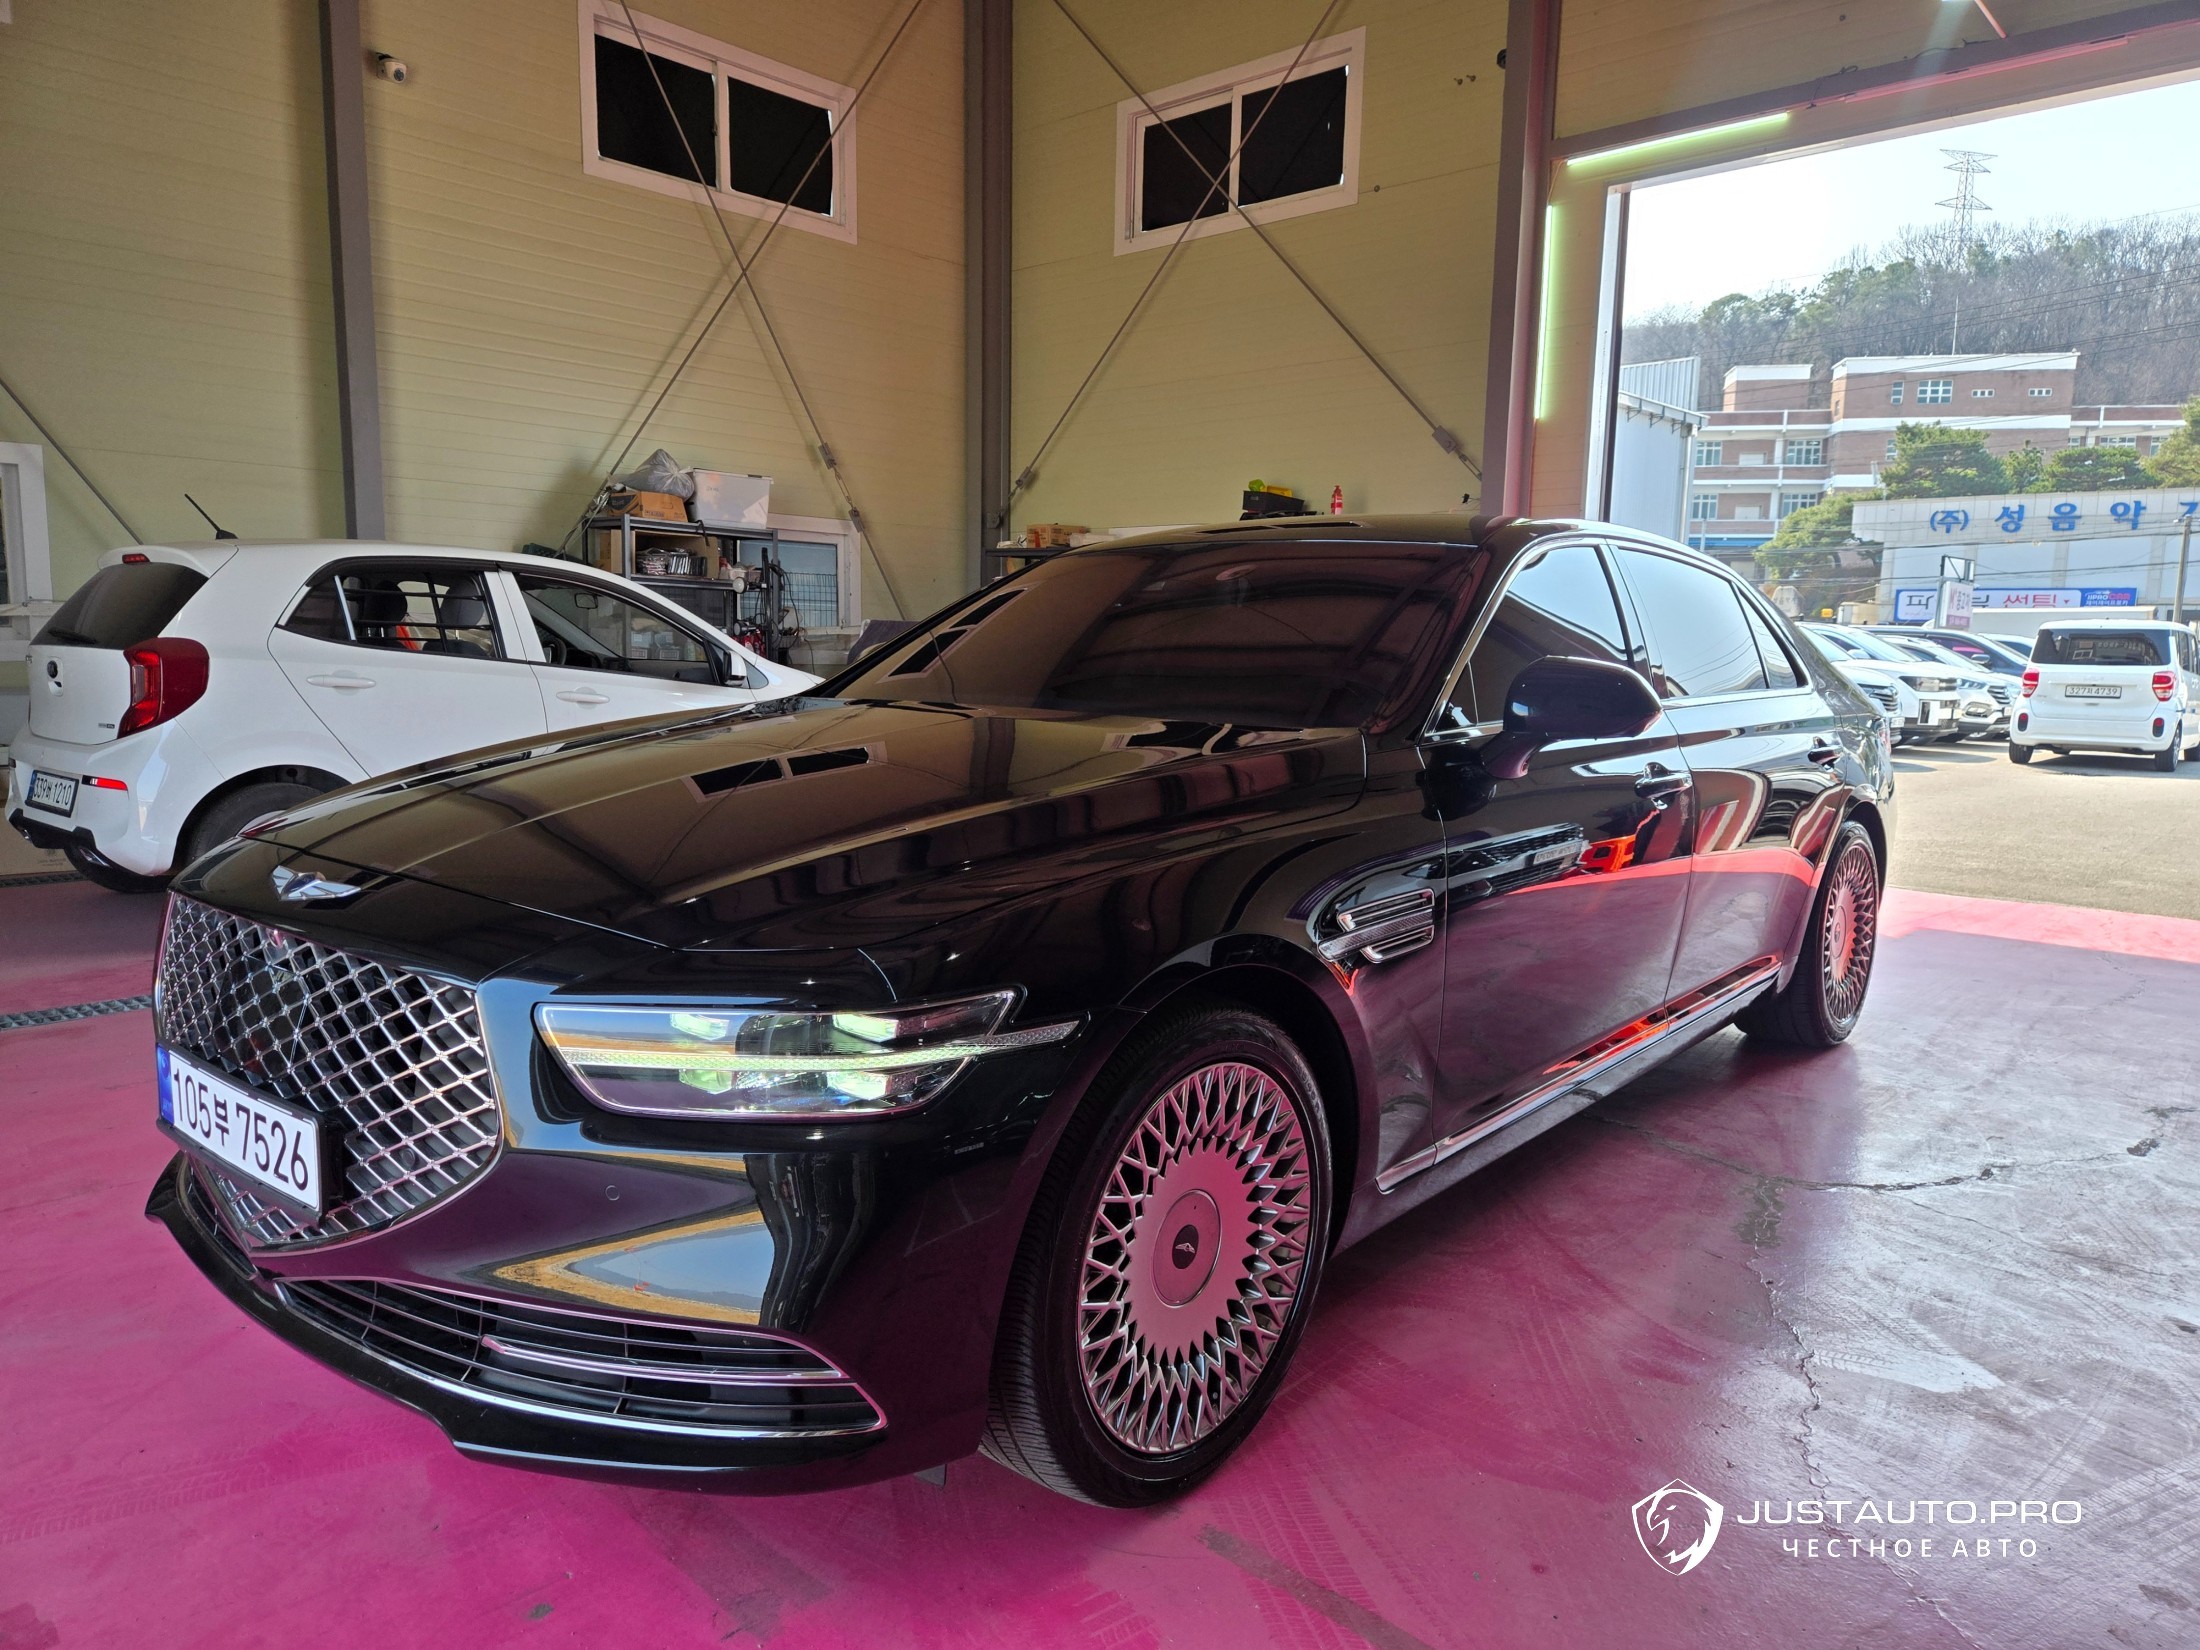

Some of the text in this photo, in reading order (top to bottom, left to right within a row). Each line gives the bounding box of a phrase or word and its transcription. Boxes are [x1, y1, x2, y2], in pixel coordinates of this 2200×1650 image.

[1930, 509, 1969, 533] (주)
[2094, 687, 2118, 696] 4739
[52, 782, 72, 806] 1210
[173, 1068, 309, 1191] 105부 7526
